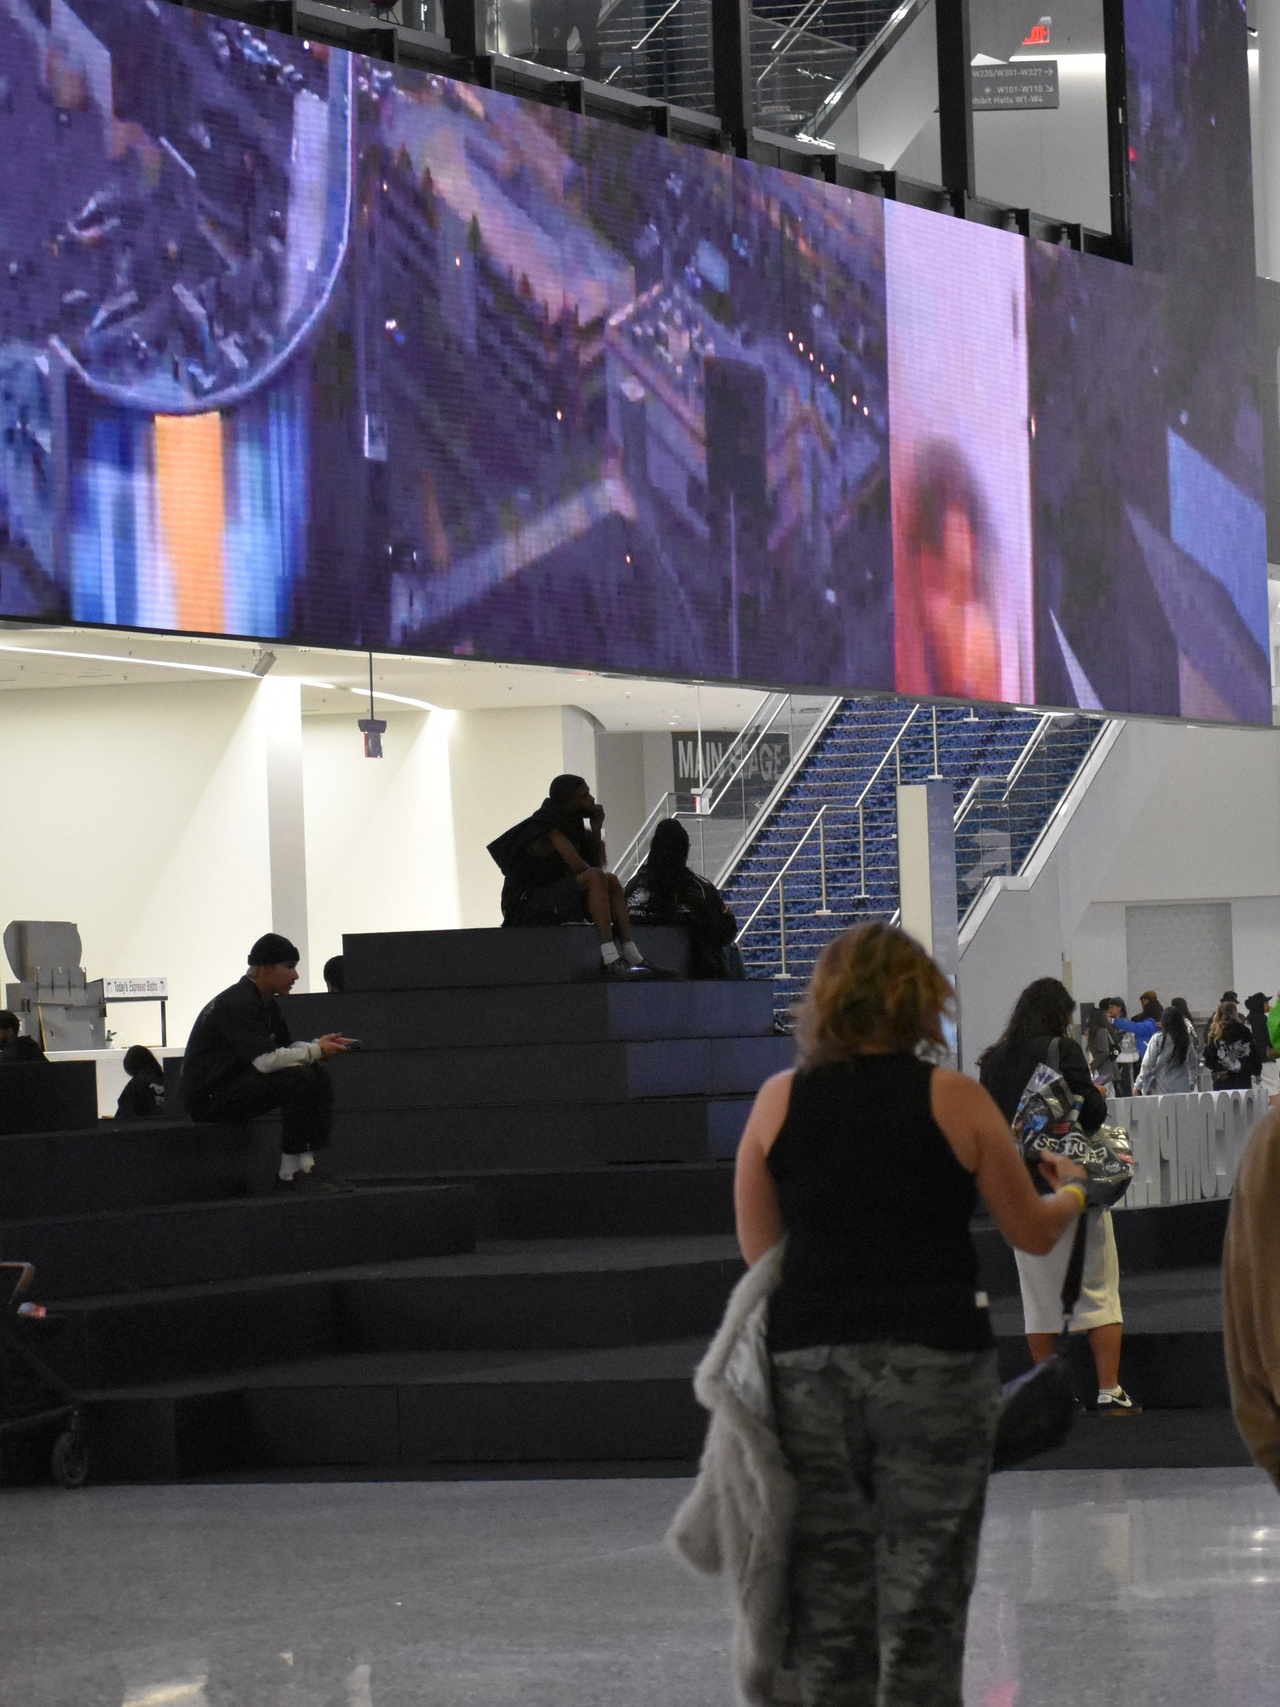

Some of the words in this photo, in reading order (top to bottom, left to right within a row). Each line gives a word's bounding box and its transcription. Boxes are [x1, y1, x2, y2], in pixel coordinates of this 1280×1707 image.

[996, 85, 1043, 94] W101-W110
[994, 96, 1014, 104] Halls
[678, 740, 725, 779] MAIN
